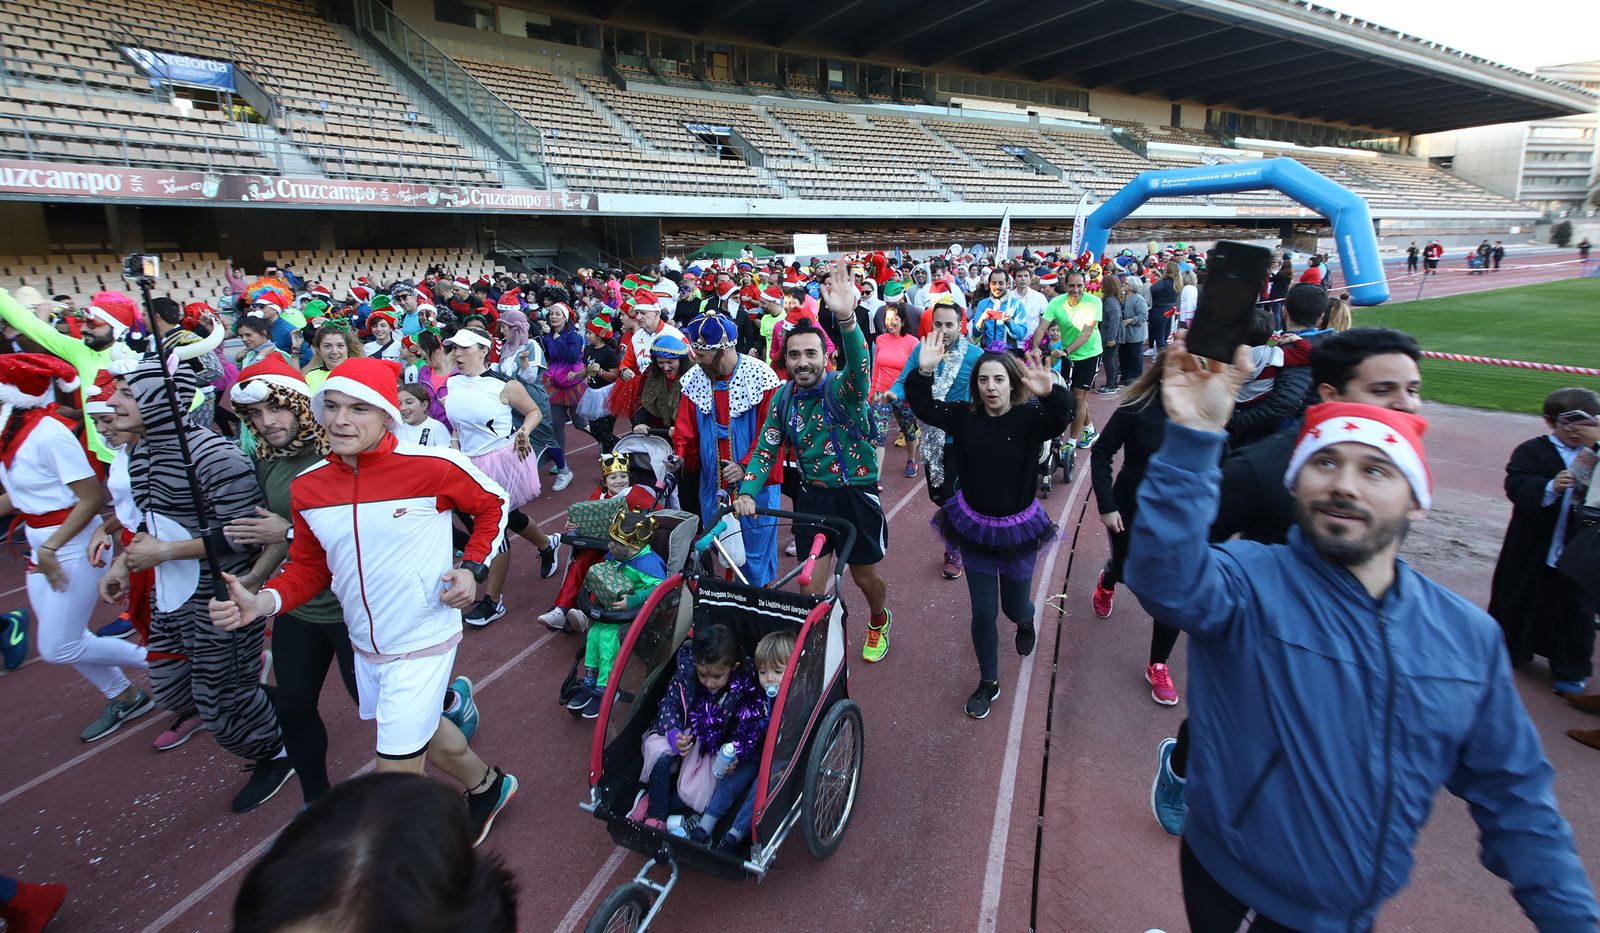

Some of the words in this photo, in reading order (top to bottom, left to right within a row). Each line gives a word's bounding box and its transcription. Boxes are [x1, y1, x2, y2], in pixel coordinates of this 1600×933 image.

[130, 175, 144, 192] SIN
[1161, 175, 1220, 184] Ayuntamiento
[277, 179, 375, 203] Cruzcampo
[471, 190, 541, 208] Cruzcampo
